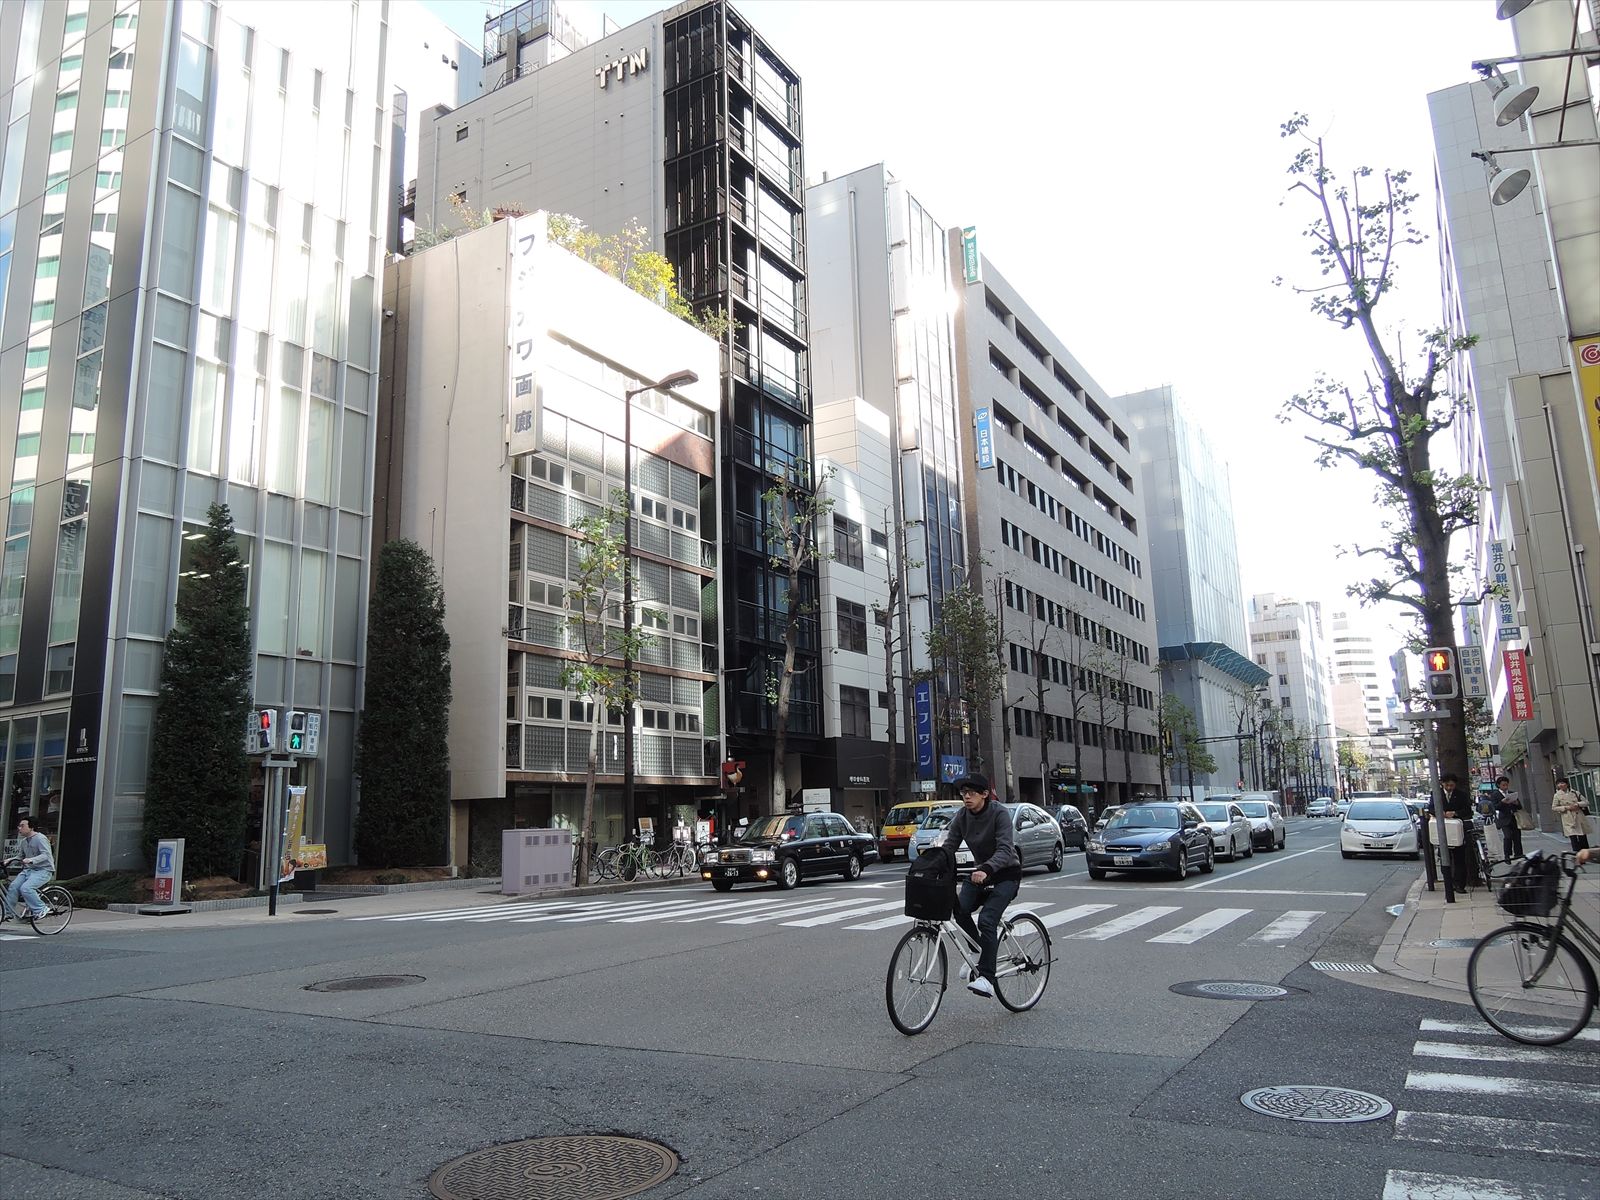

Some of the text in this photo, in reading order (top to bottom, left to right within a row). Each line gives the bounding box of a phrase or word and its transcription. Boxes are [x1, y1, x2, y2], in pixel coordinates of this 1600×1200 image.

[595, 46, 648, 89] TTN
[1462, 649, 1473, 674] 自転車
[1471, 648, 1482, 675] 歩行者
[1470, 676, 1480, 694] 専用
[1508, 651, 1528, 717] 福井県大阪事務所
[917, 691, 931, 766] エフワン
